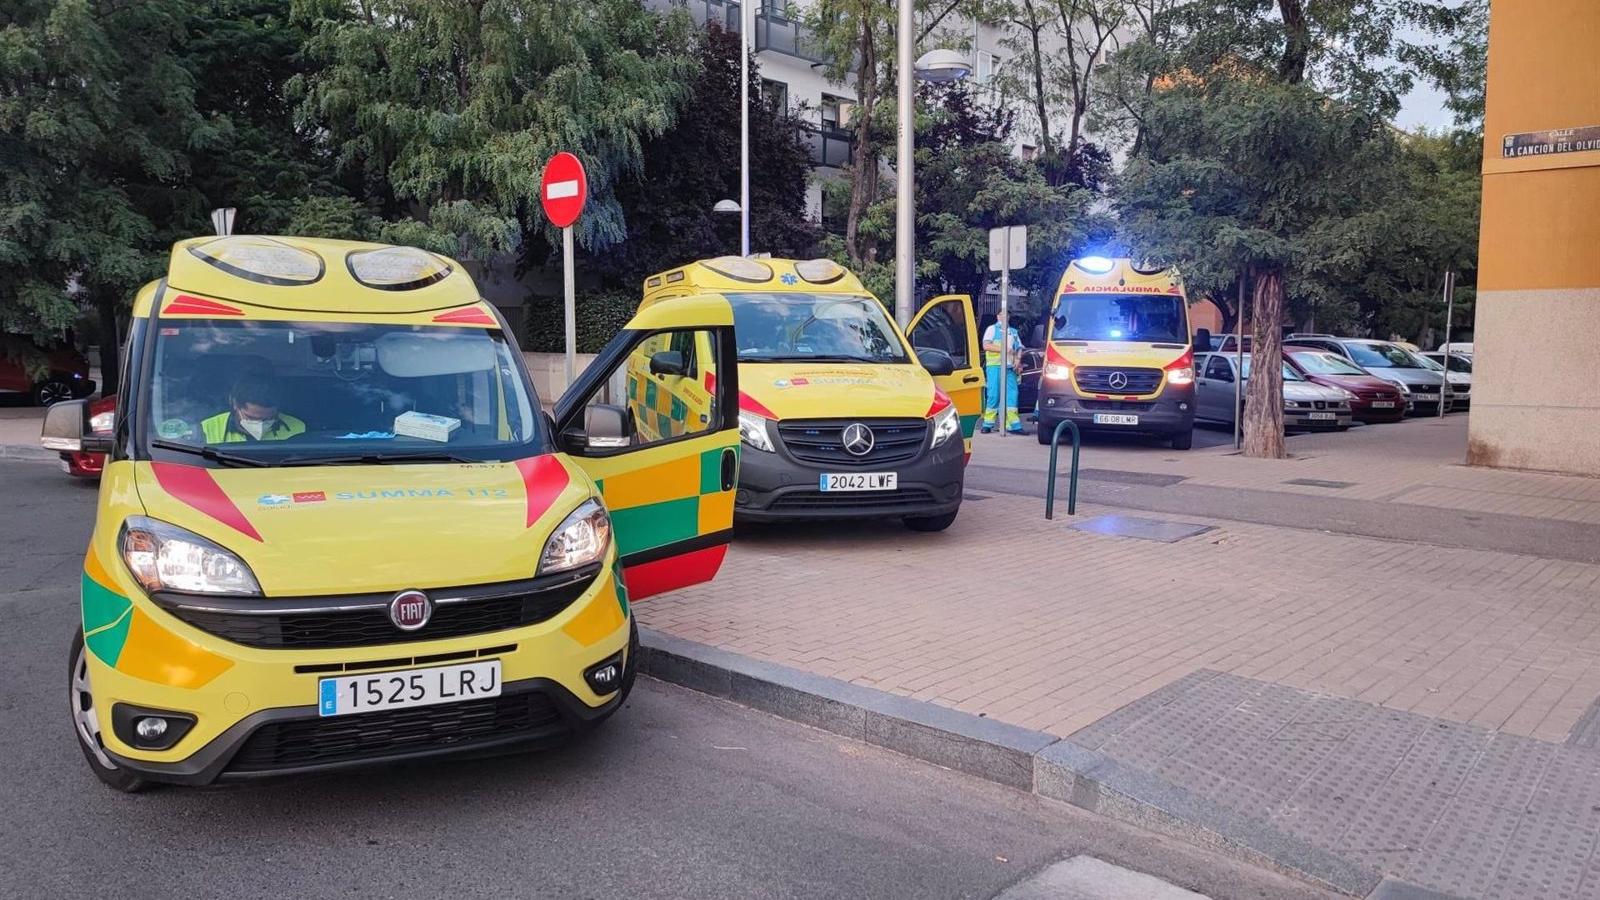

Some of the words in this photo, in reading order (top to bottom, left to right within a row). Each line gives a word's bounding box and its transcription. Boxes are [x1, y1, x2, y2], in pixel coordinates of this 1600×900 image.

[1504, 147, 1514, 157] LA
[1517, 143, 1554, 156] CANCION
[1557, 141, 1572, 152] DEL
[830, 475, 864, 489] 2042
[869, 474, 894, 488] LWF
[336, 489, 454, 501] SUMMA
[466, 488, 510, 497] 112
[401, 602, 424, 621] FIAT
[325, 701, 333, 709] E
[349, 674, 426, 707] 1525
[439, 666, 496, 698] LRJ
